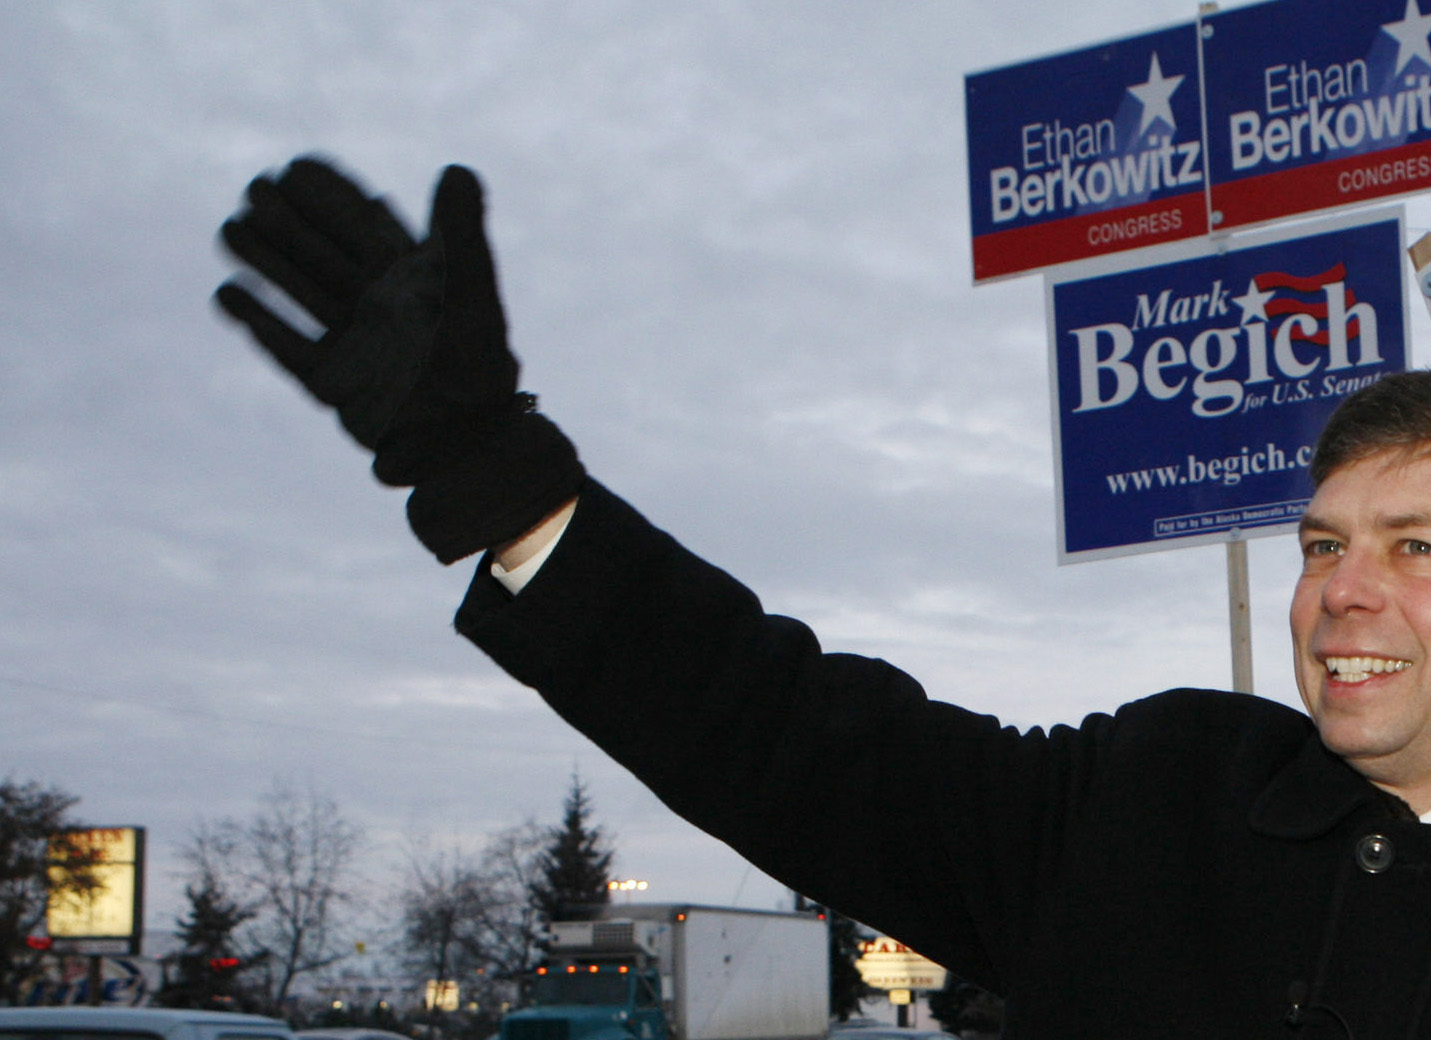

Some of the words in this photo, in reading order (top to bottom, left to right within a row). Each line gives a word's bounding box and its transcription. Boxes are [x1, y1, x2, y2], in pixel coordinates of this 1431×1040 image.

[1265, 56, 1369, 115] Ethan
[1022, 119, 1116, 171] Ethan
[990, 134, 1203, 224] Berkowitz
[1087, 209, 1183, 246] CONGRESS
[1131, 279, 1232, 332] Mark
[1068, 281, 1385, 418] Begich
[1241, 393, 1268, 413] for
[1272, 379, 1314, 404] U.S.
